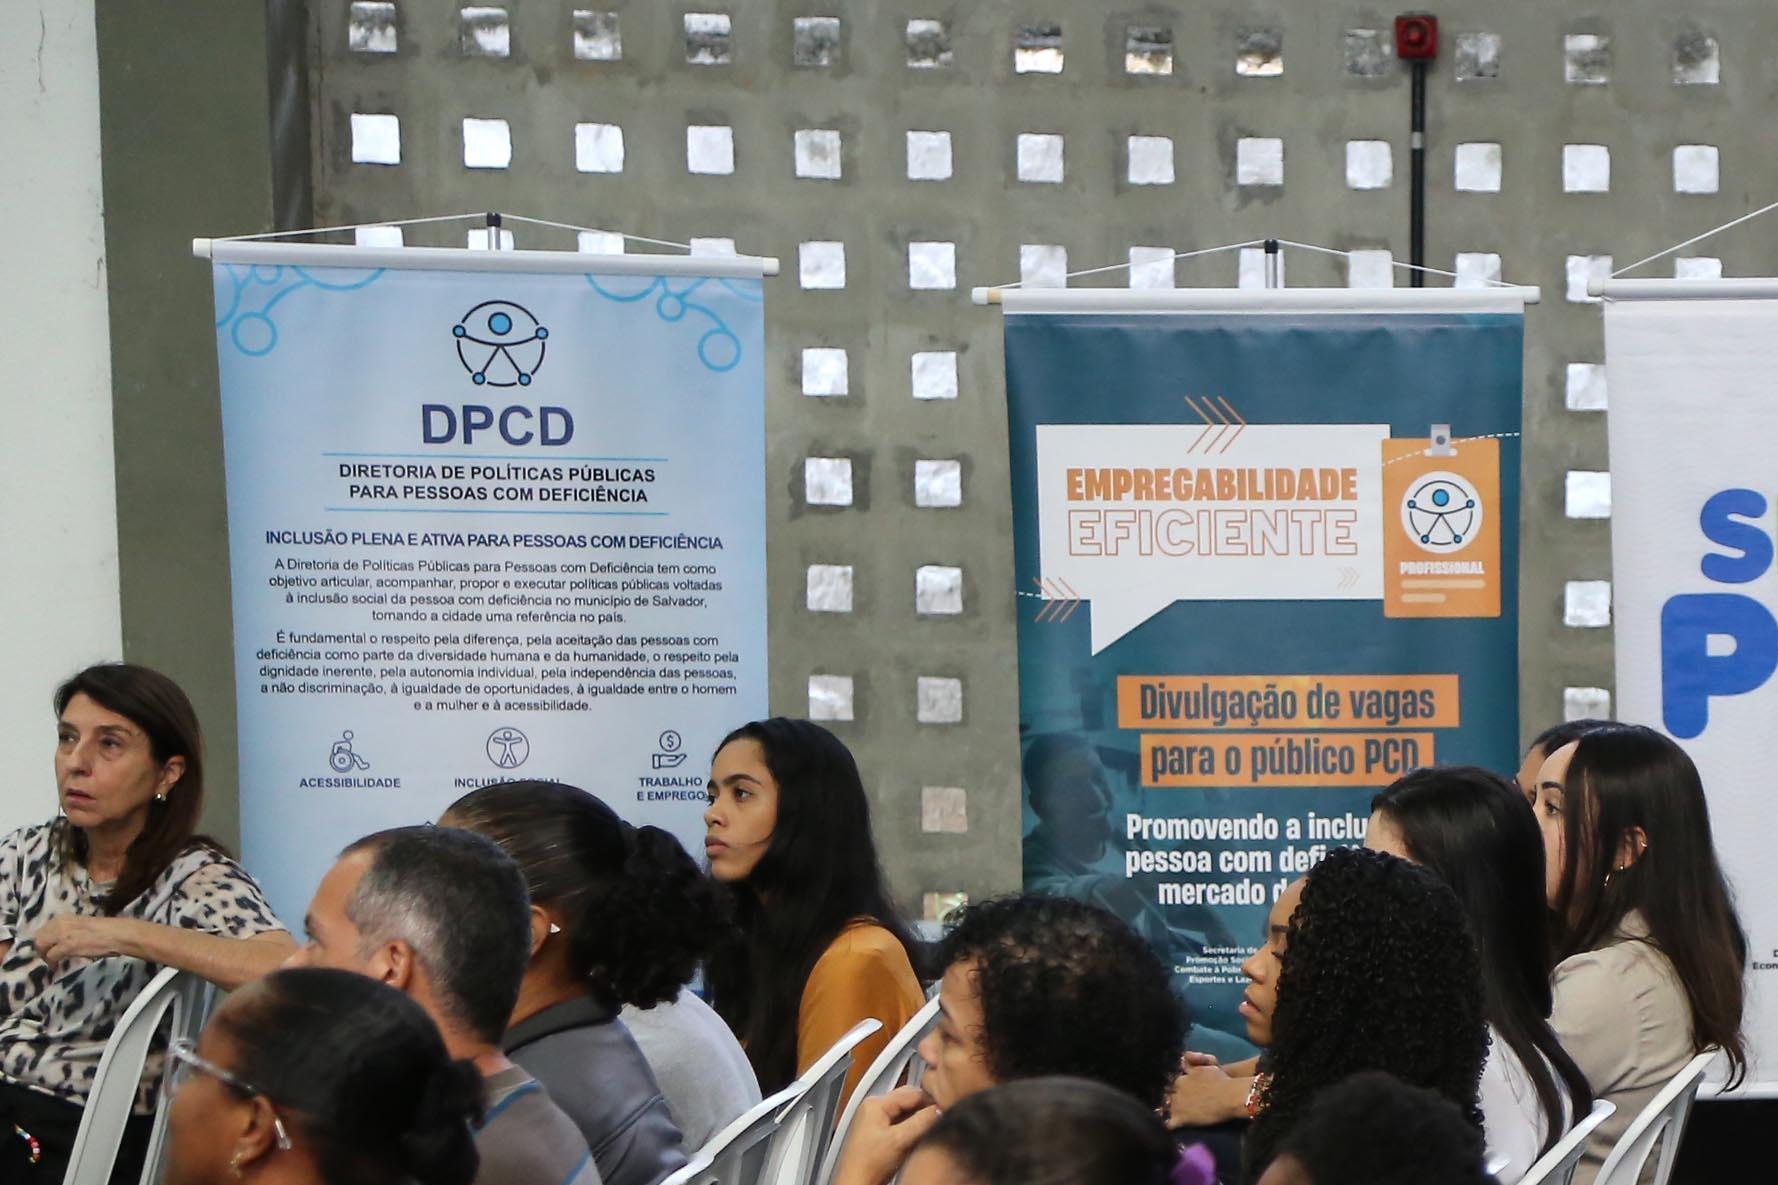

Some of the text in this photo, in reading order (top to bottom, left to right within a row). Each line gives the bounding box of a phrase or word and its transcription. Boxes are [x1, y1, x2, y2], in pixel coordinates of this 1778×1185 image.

[421, 404, 574, 446] DPCD
[339, 462, 655, 482] DIRETORIA DE POLÍTICAS PÚBLICAS
[349, 484, 647, 502] PARA PESSOAS COM DEFICIÊNCIA
[1066, 468, 1358, 501] EMPREGABILIDADE
[265, 529, 723, 549] INCLUSÃO PLENA E ATIVA PARA PESSOAS COM DEFICIÊNCIA
[1068, 508, 1358, 556] EFICIENTE
[274, 557, 716, 574] A Diretoria de Políticas Públicas para Pessoas com Deficiência tem como
[268, 574, 722, 592] objetivo articular, acompanhar, propor executar políticas públicas voltadas
[296, 591, 707, 608] inclusão social da pessoa com deficiência no município de Salvador,
[430, 612, 438, 621] a
[441, 610, 482, 621] cidade
[485, 612, 512, 622] uma
[516, 610, 576, 622] referência
[579, 613, 595, 622] no
[597, 611, 625, 624] país.
[276, 629, 718, 648] É fundamental o respeito pela diferença, pela aceitação das pessoas com
[255, 648, 739, 664] deficiência como parte da diversidade humana da humanidade, respeito pela
[258, 665, 736, 681] dignidade inerente, pela autonomia individual, pela independência das pessoas,
[260, 681, 736, 697] a não discriminação, igualdade de oportunidades, igualdade entre o homem
[424, 699, 591, 711] a mulher acessibilidade.
[1140, 682, 1436, 726] Divulgação de vagas
[1151, 737, 1419, 783] para o público PCD
[299, 778, 401, 788] ACESSIBILIDADE
[639, 777, 703, 787] TRABALHO
[637, 791, 705, 801] E EMPREGO
[1126, 813, 1279, 840] Promovendo
[1286, 818, 1301, 840] a
[1126, 850, 1212, 878] pessoa
[1219, 850, 1272, 873] com
[1158, 878, 1266, 905] mercado
